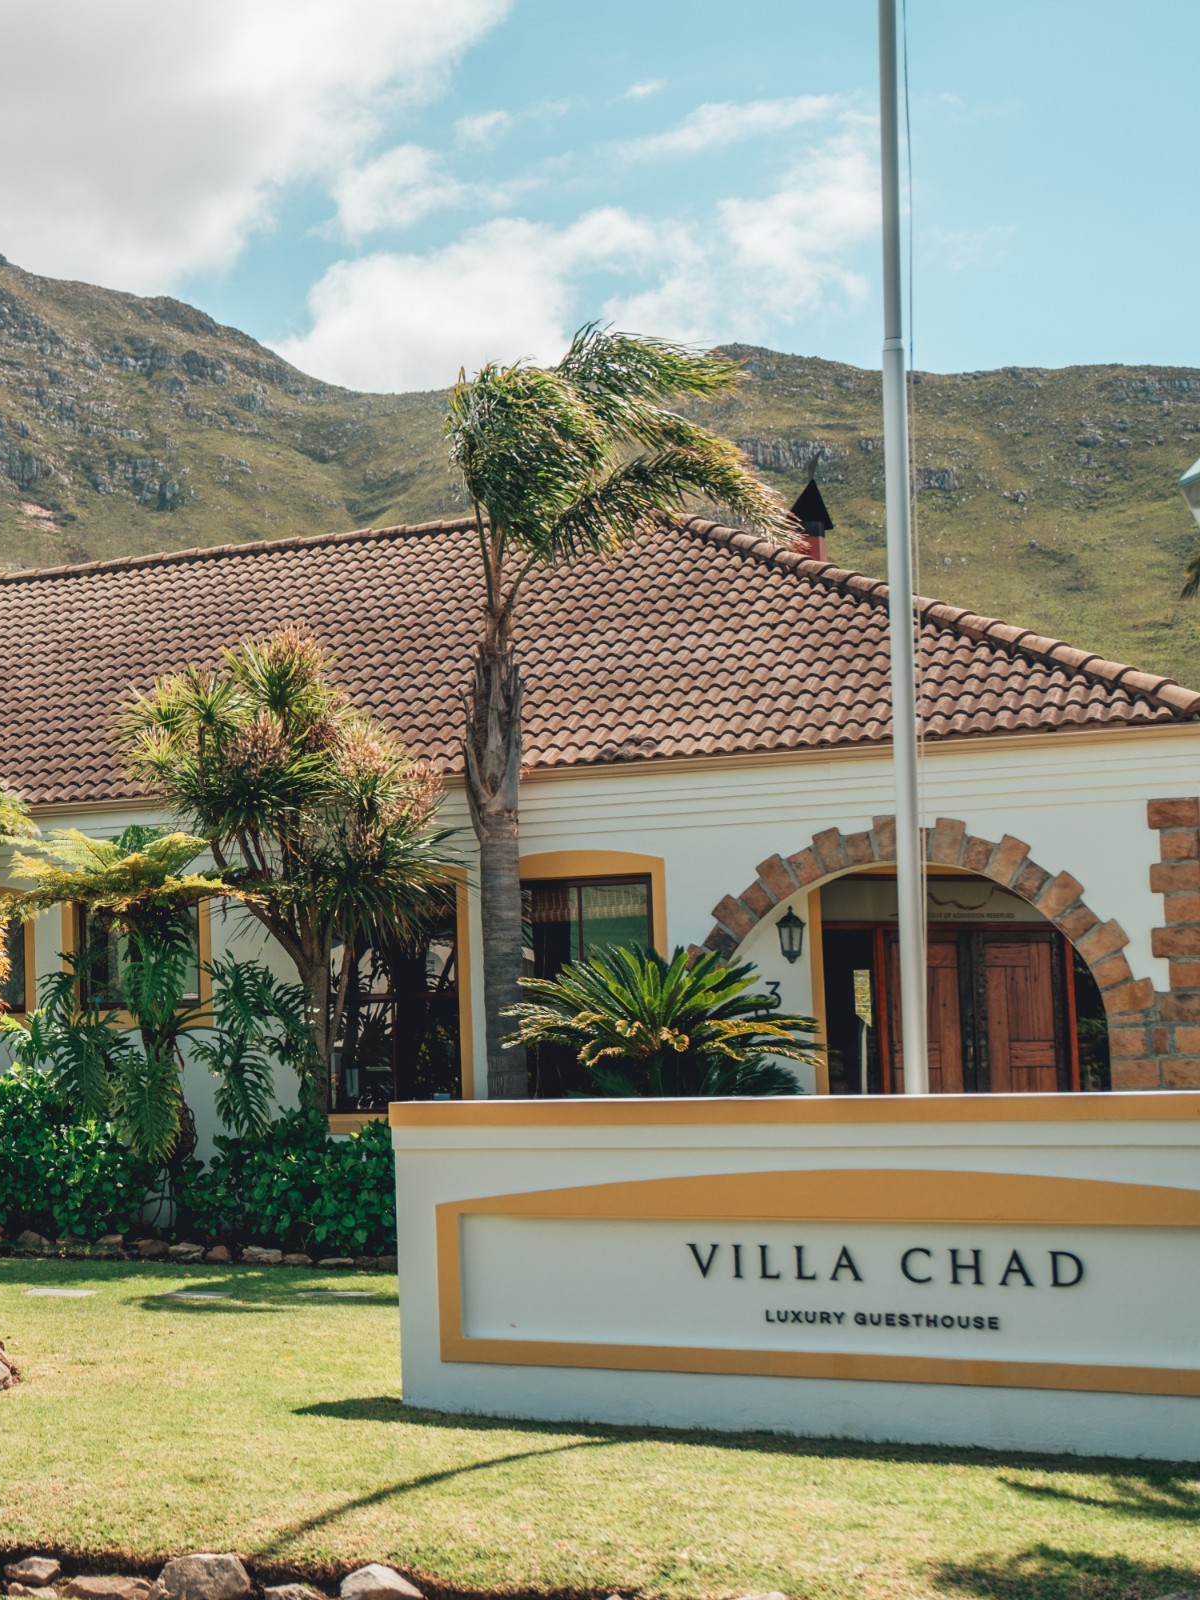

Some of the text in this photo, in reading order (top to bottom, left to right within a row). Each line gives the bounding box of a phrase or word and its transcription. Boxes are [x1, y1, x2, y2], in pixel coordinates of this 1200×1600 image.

[686, 1242, 1088, 1289] VILLA CHAD
[765, 1309, 1001, 1331] LUXURY GUESTHOUSE
